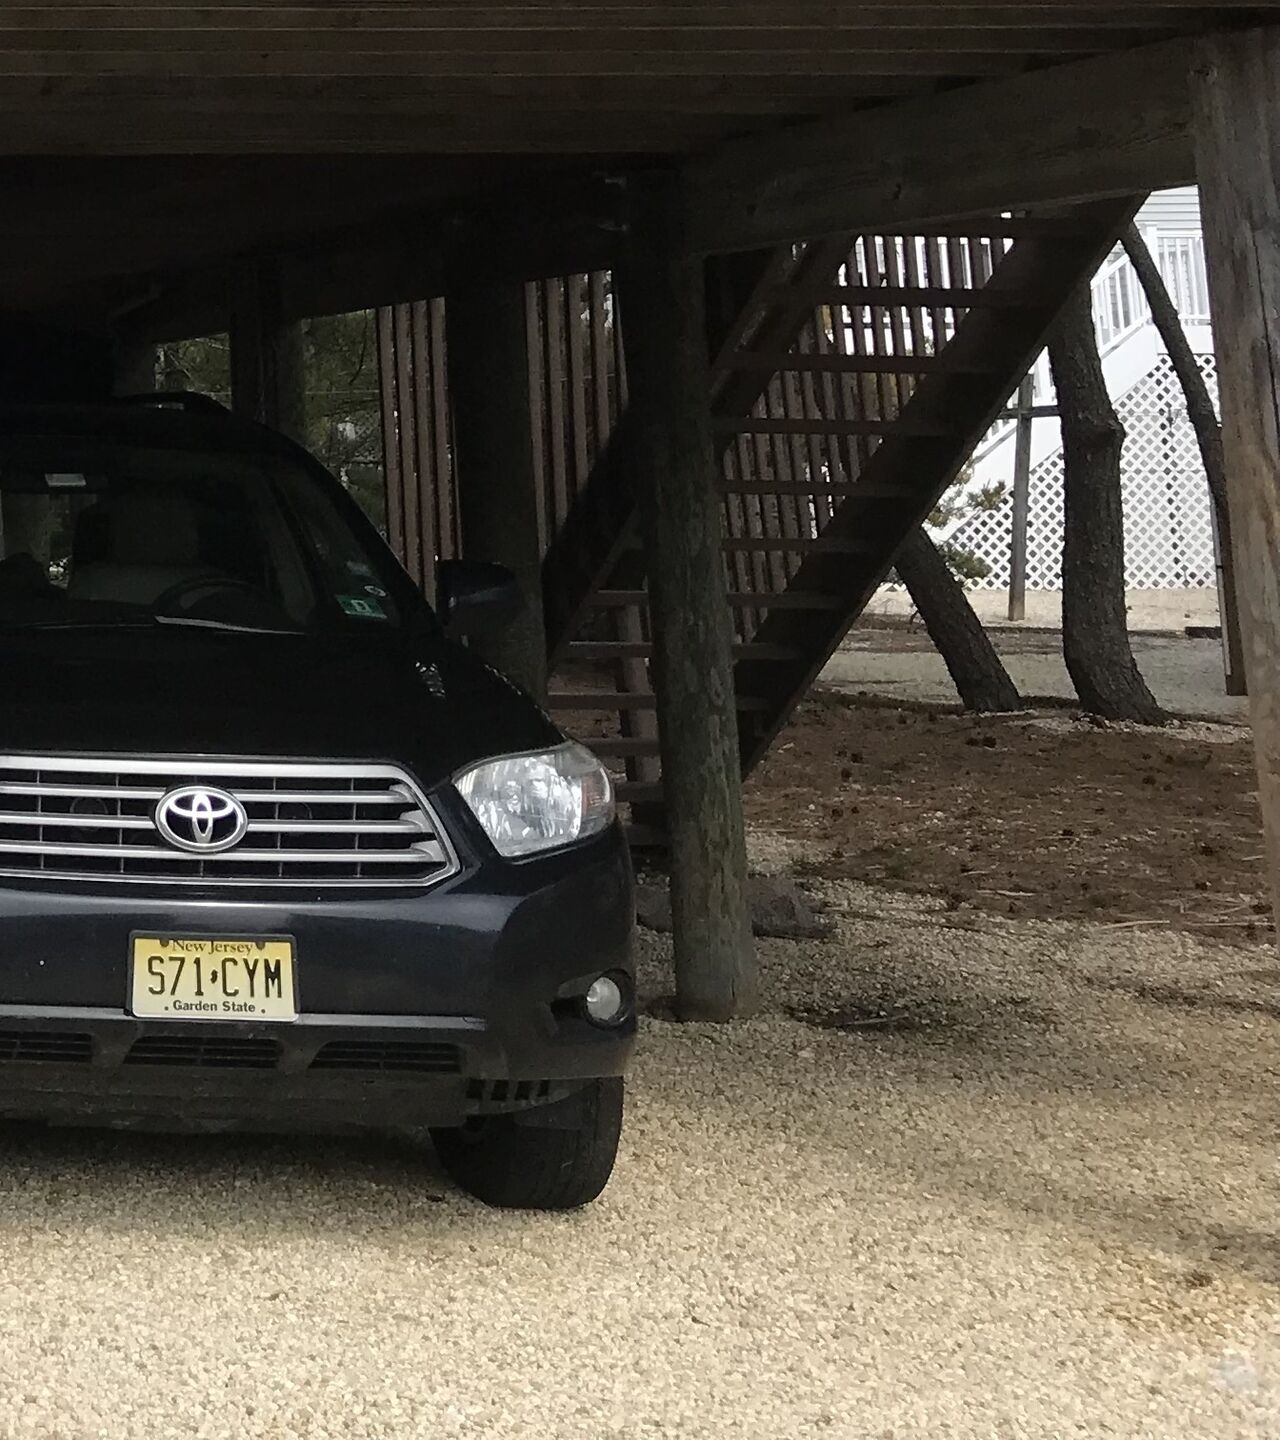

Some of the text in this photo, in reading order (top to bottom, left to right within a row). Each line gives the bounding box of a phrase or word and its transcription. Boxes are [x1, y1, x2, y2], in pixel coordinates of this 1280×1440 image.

[172, 940, 254, 956] New Jersey
[172, 999, 256, 1013] Garden State
